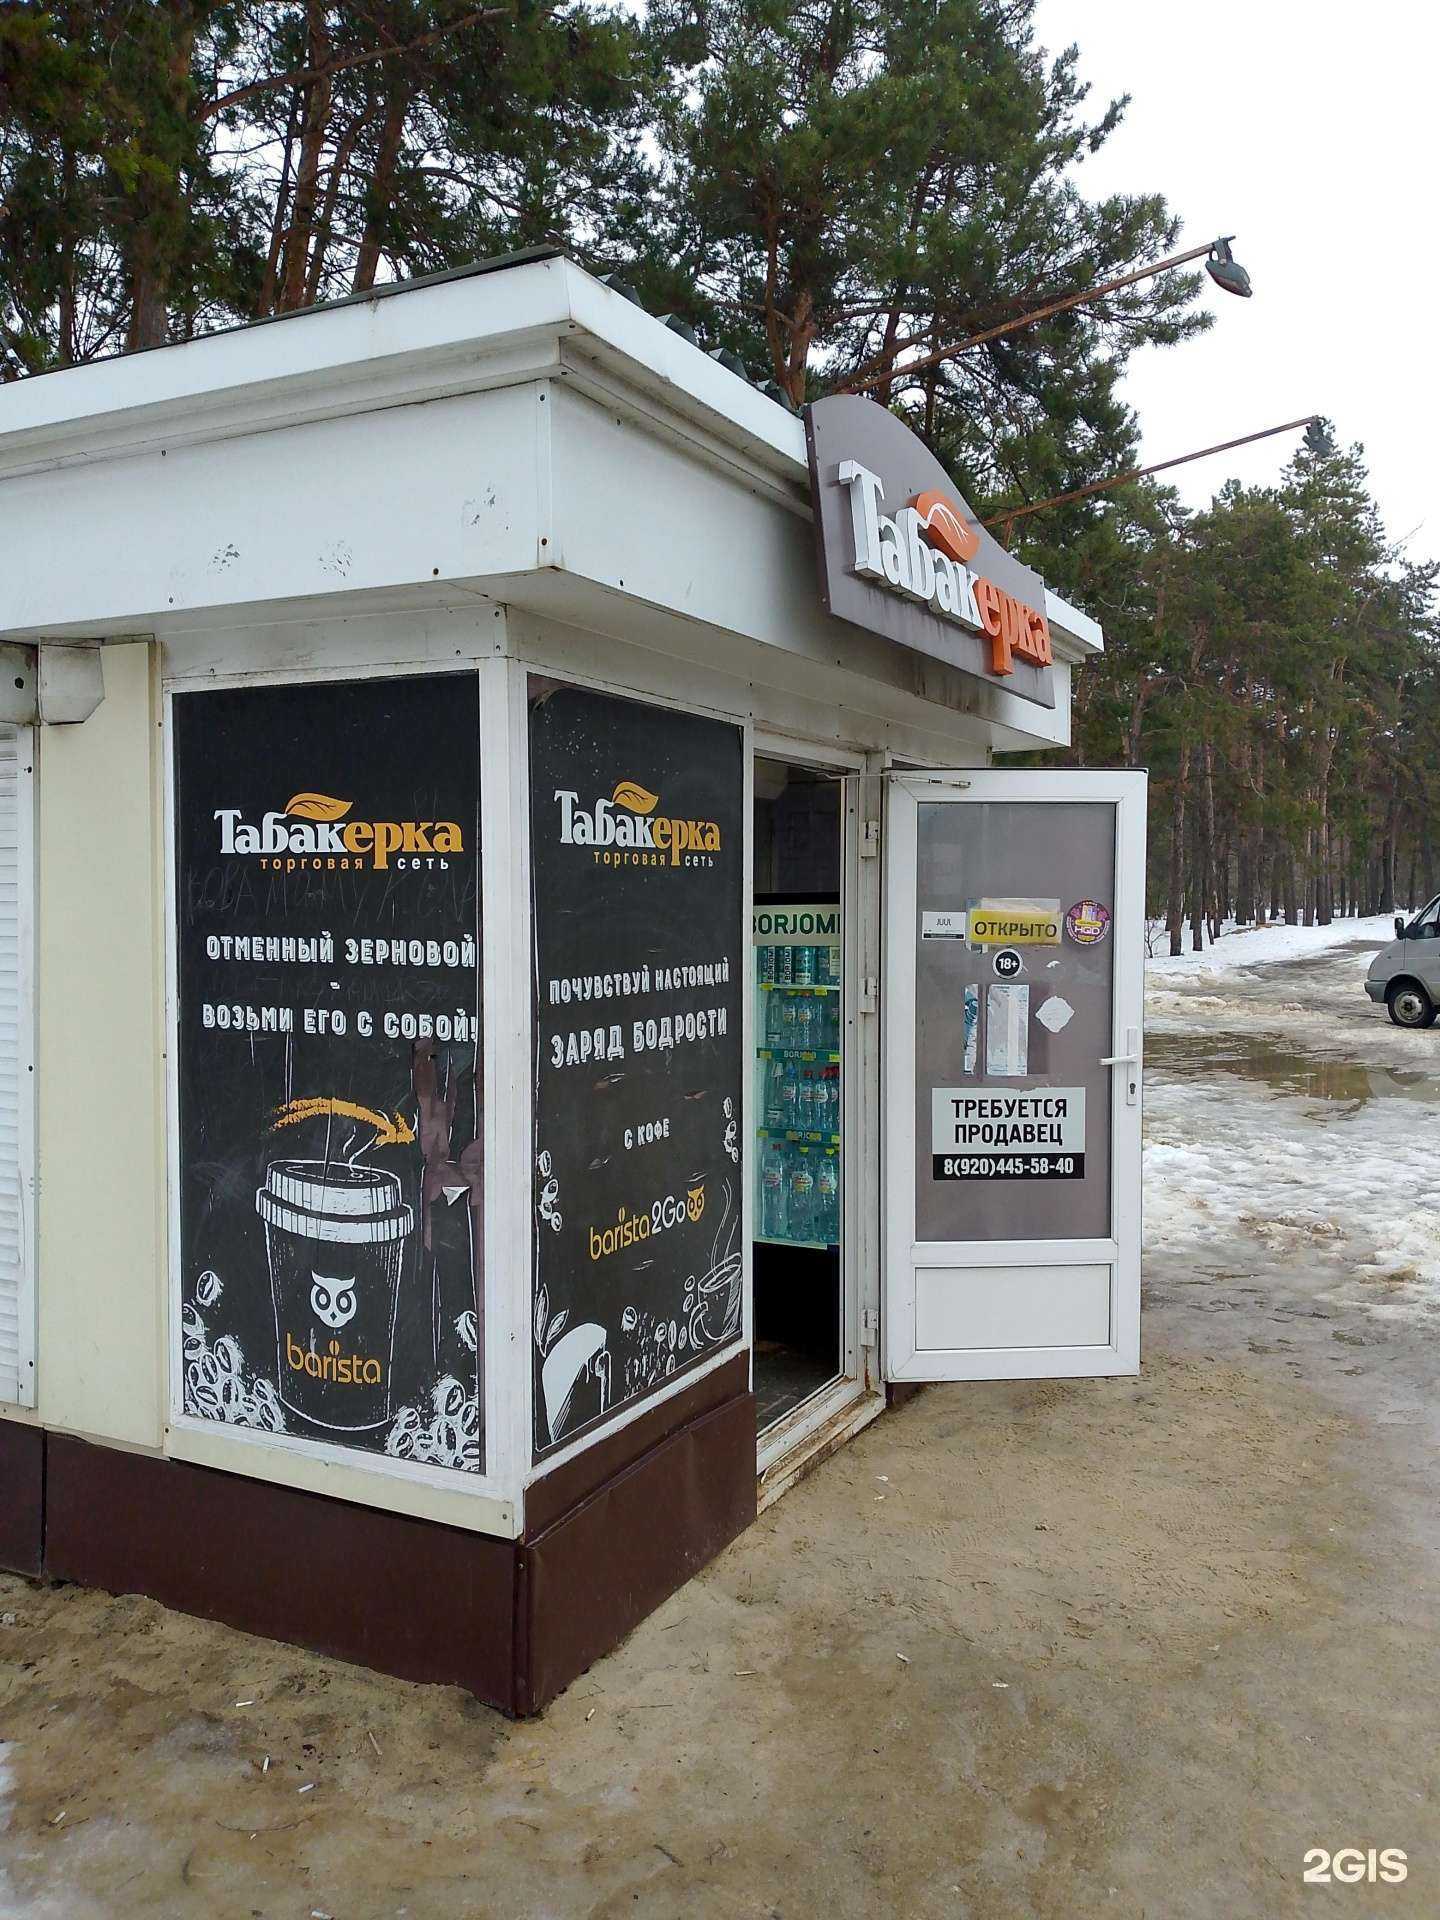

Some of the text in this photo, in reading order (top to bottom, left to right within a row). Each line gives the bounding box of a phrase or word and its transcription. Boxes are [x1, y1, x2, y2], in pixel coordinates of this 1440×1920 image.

[839, 459, 1052, 677] Табакерка
[214, 809, 464, 869] Табакерка
[553, 789, 720, 867] Табакерка
[260, 856, 449, 873] торговая сеть
[594, 850, 714, 869] торговая сеть
[974, 920, 1058, 940] ОТКРЫТО
[206, 930, 476, 968] ОТМЕННЫЙ ЗЕРНОВОЙ
[998, 957, 1019, 970] 18+
[549, 957, 729, 1005] ПОЧУВСТВУЙ НАСТОЯЩИЙ
[202, 1004, 478, 1043] ВОЗЬМИ ЕГО С СОБОЙ!
[550, 1007, 727, 1069] ЗАРЯД БОДРОСТИ
[951, 1098, 1067, 1119] ТРЕБУЕТСЯ
[624, 1118, 671, 1150] С КОФЕ
[954, 1124, 1063, 1146] ПРОДАВЕЦ
[943, 1157, 1074, 1178] 8(920)445-58-40
[286, 1333, 382, 1384] barista
